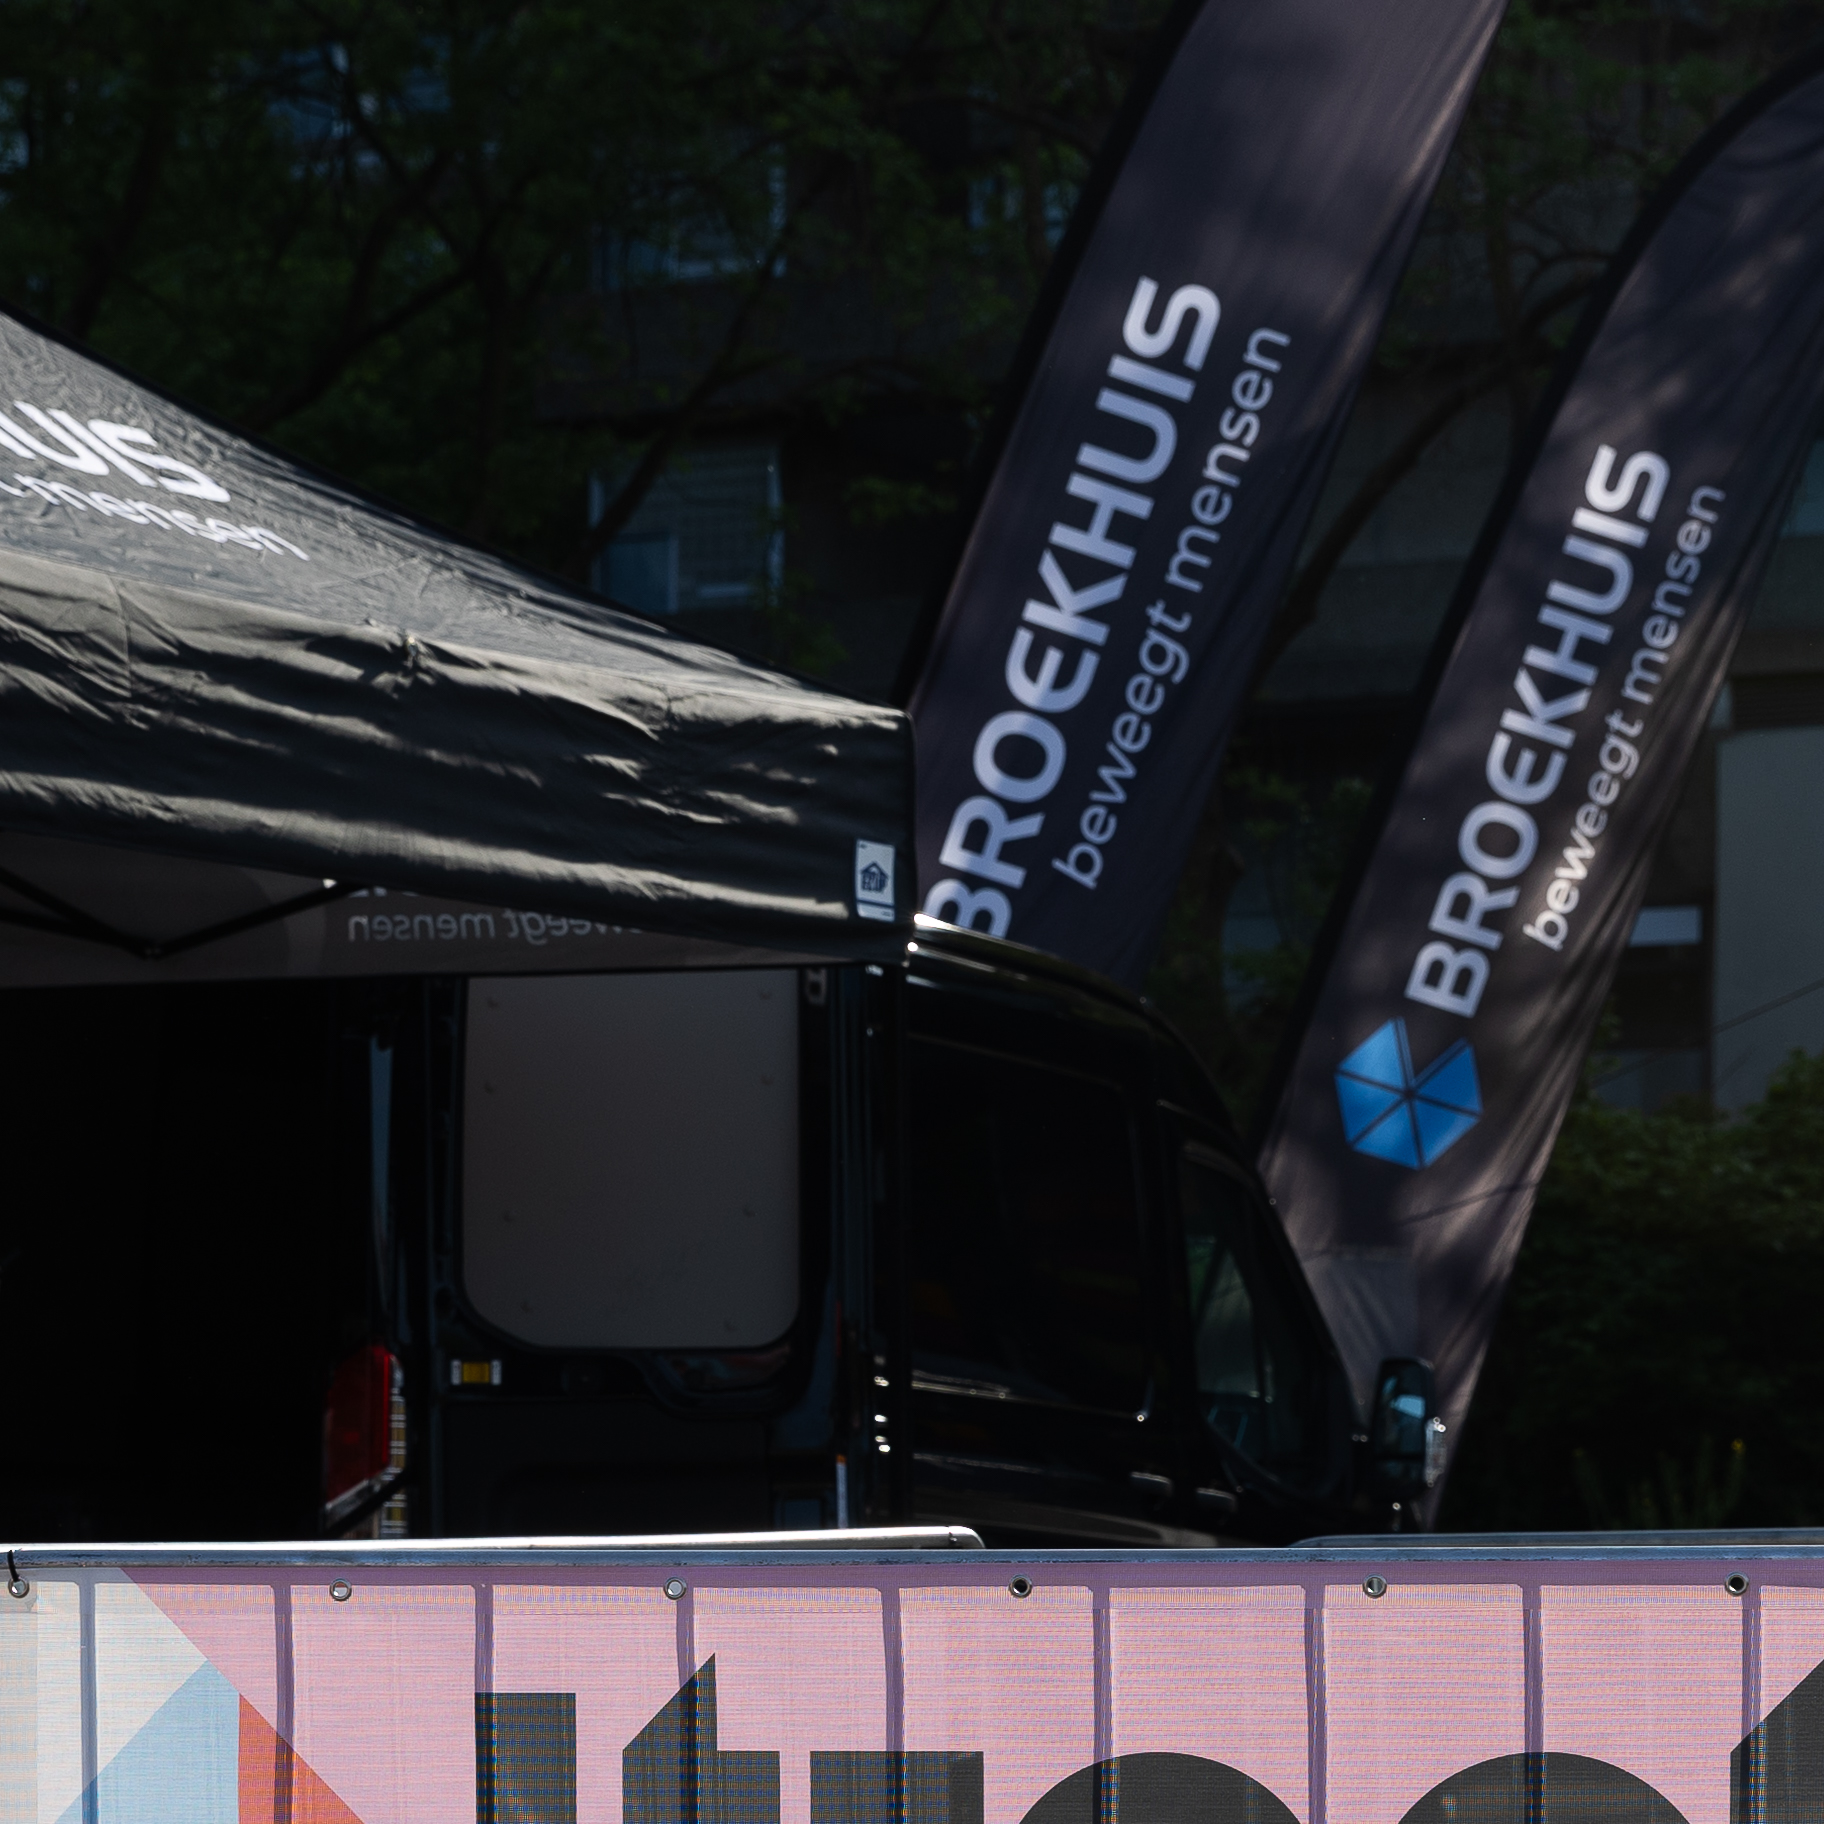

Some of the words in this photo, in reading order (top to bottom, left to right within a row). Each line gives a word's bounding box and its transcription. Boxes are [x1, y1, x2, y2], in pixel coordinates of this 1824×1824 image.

[14, 474, 311, 561] mensen
[923, 275, 1222, 940] BROEKHUIS
[1052, 599, 1193, 890] beweegt
[1165, 326, 1291, 593] mensen
[1404, 444, 1672, 1019] BROEKHUIS
[1523, 708, 1644, 952] beweegt
[1621, 484, 1727, 706] mensen
